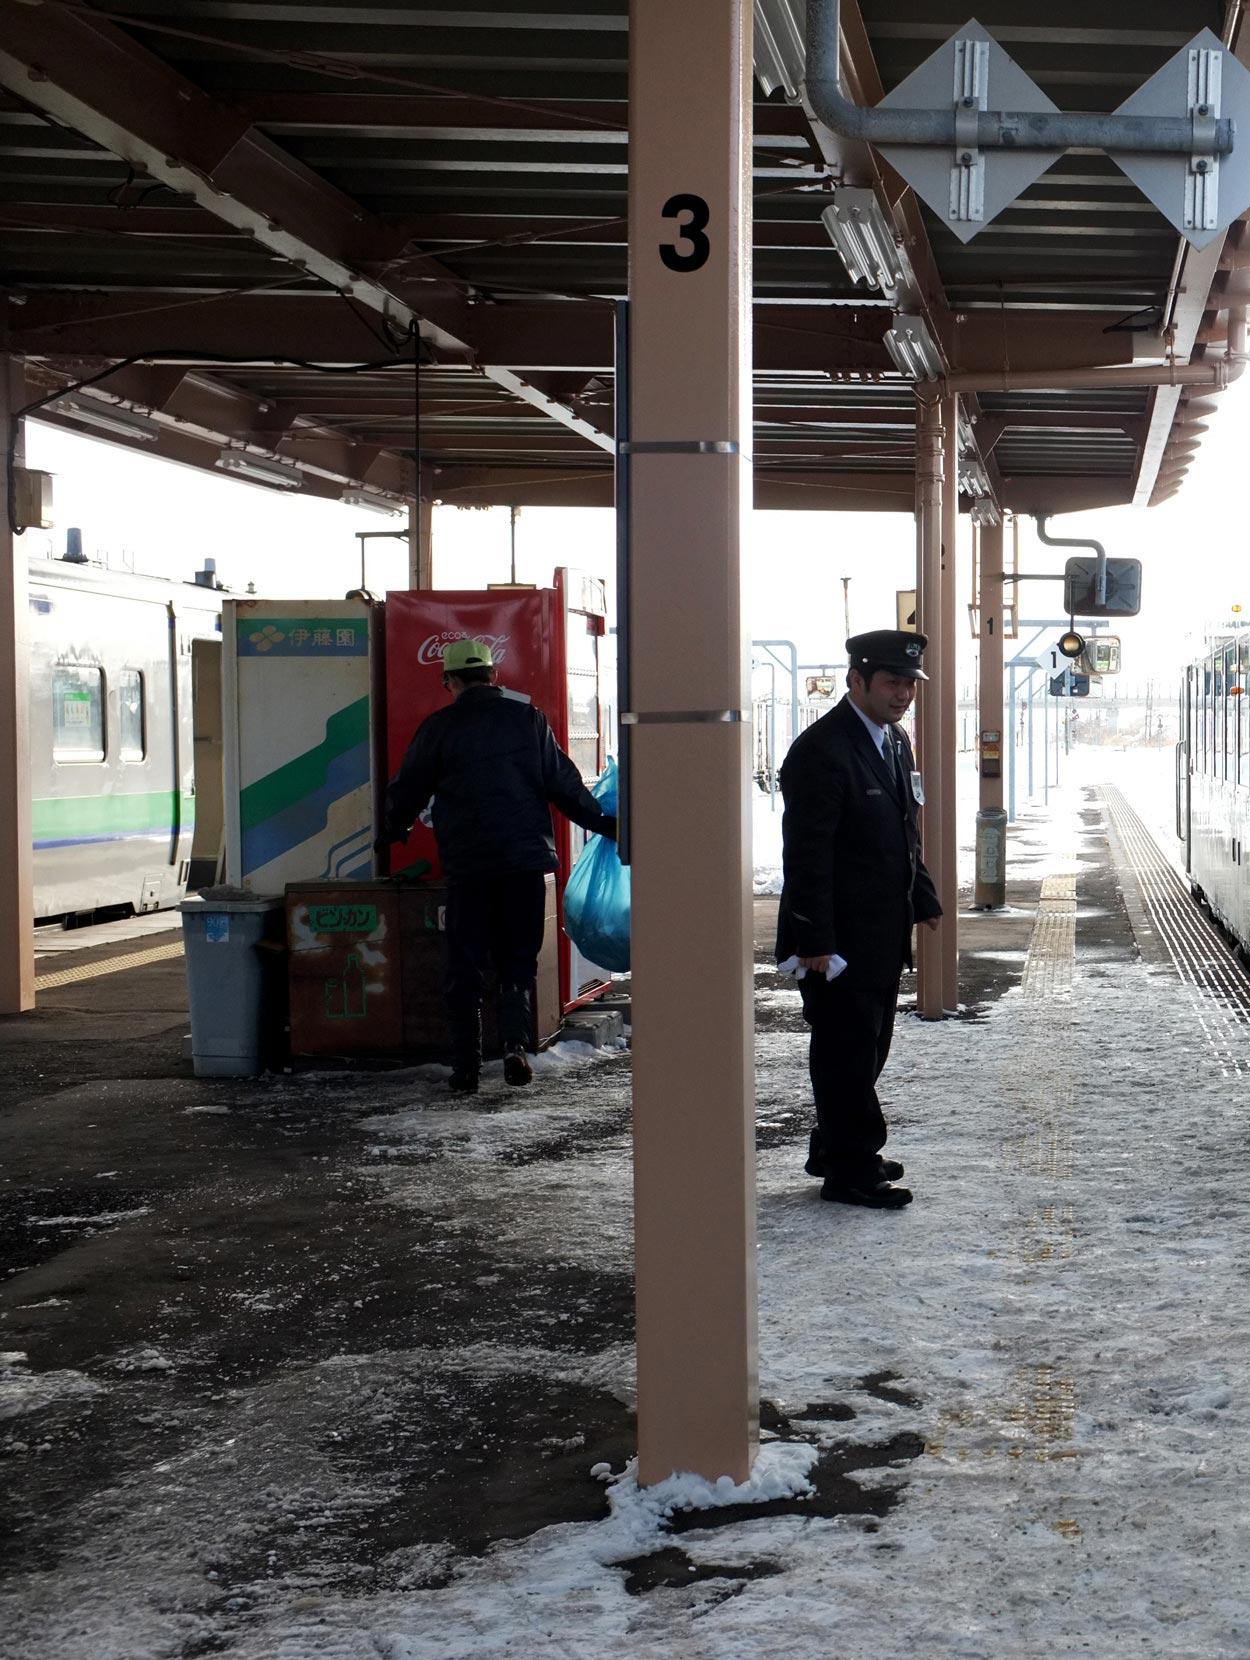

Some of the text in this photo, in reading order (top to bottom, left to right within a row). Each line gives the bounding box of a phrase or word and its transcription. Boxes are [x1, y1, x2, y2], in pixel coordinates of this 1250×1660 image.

[659, 194, 710, 272] 3
[987, 617, 994, 635] 1
[288, 628, 355, 647] 伊藤園
[1050, 651, 1057, 669] 1
